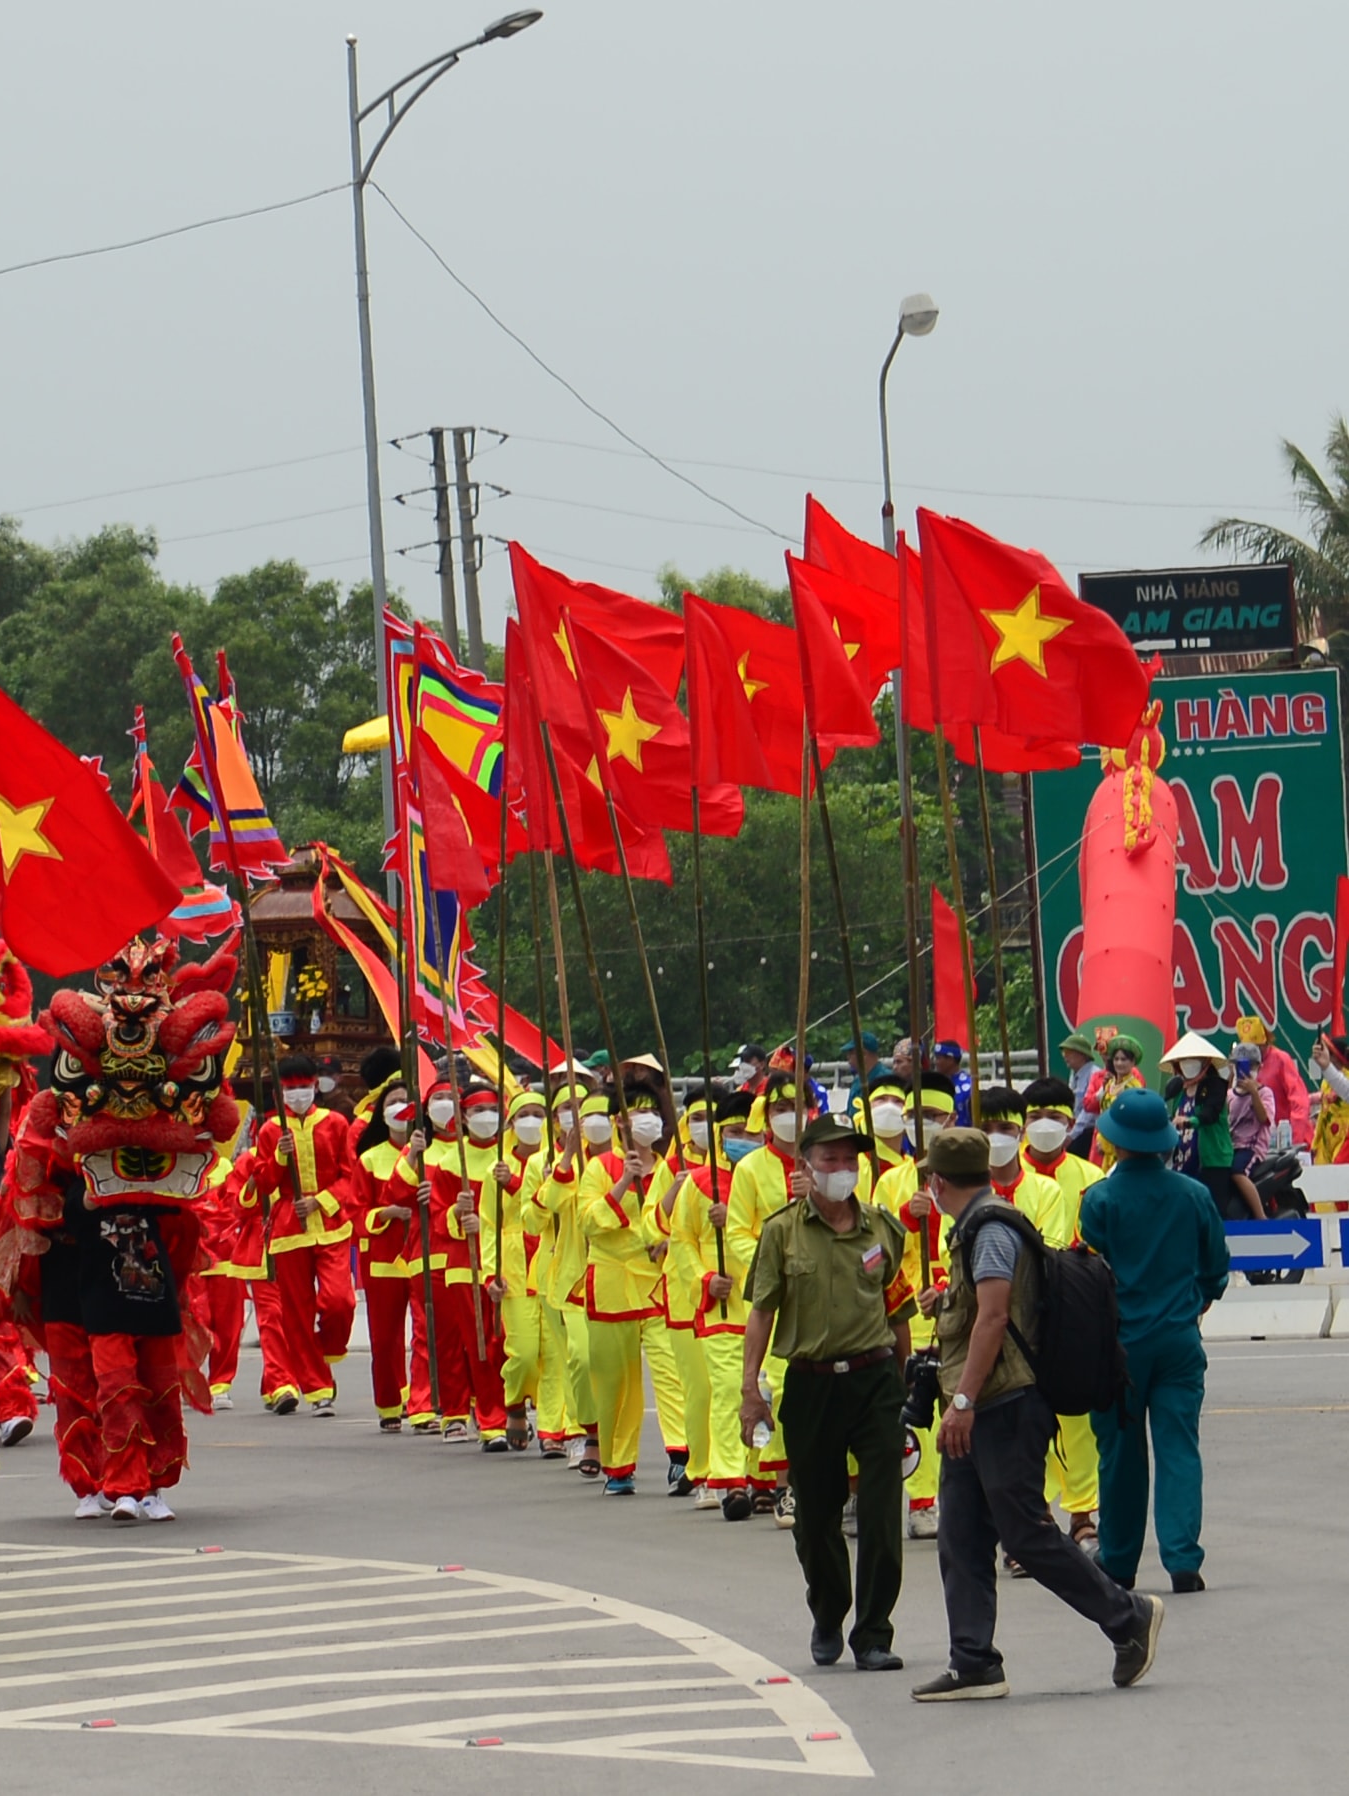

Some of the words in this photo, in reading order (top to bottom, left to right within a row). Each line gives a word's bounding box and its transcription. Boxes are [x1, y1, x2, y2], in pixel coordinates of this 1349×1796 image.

[1135, 580, 1178, 602] NHÀ
[1184, 579, 1240, 599] HÀNG
[1122, 609, 1171, 634] AM
[1182, 604, 1282, 632] GIANG
[1175, 688, 1328, 742] HÀNG
[1169, 772, 1289, 895] AM
[1055, 911, 1336, 1036] ANG
